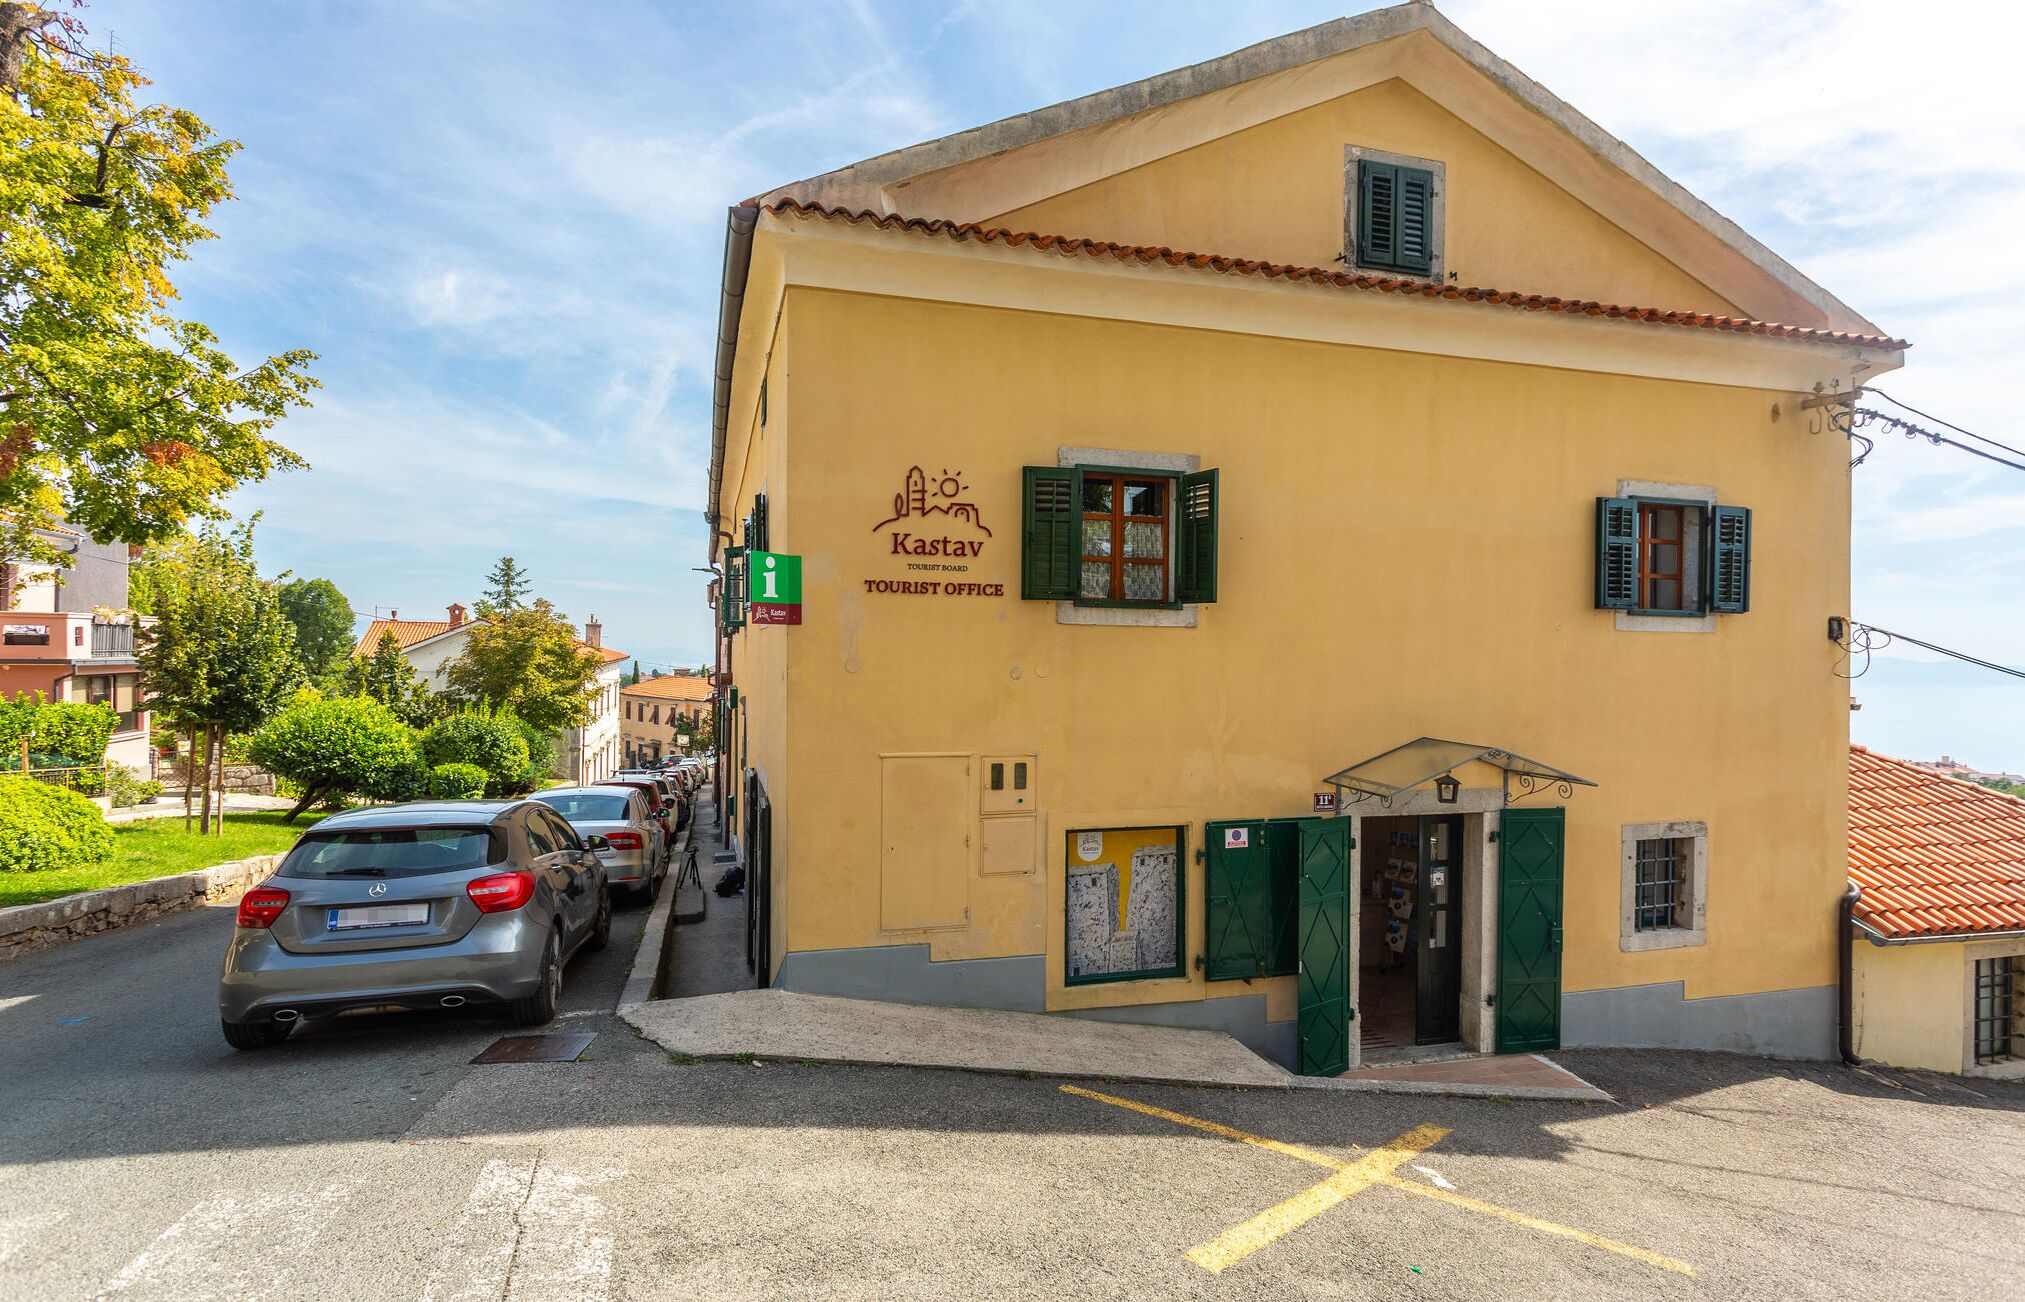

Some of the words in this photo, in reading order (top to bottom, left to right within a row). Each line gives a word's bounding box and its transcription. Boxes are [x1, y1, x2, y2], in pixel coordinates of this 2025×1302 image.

[891, 532, 984, 557] Kastav
[907, 563, 940, 571] TOURIST
[941, 564, 968, 572] BOARD
[864, 579, 941, 595] TOURIST
[944, 582, 1004, 597] OFFICE
